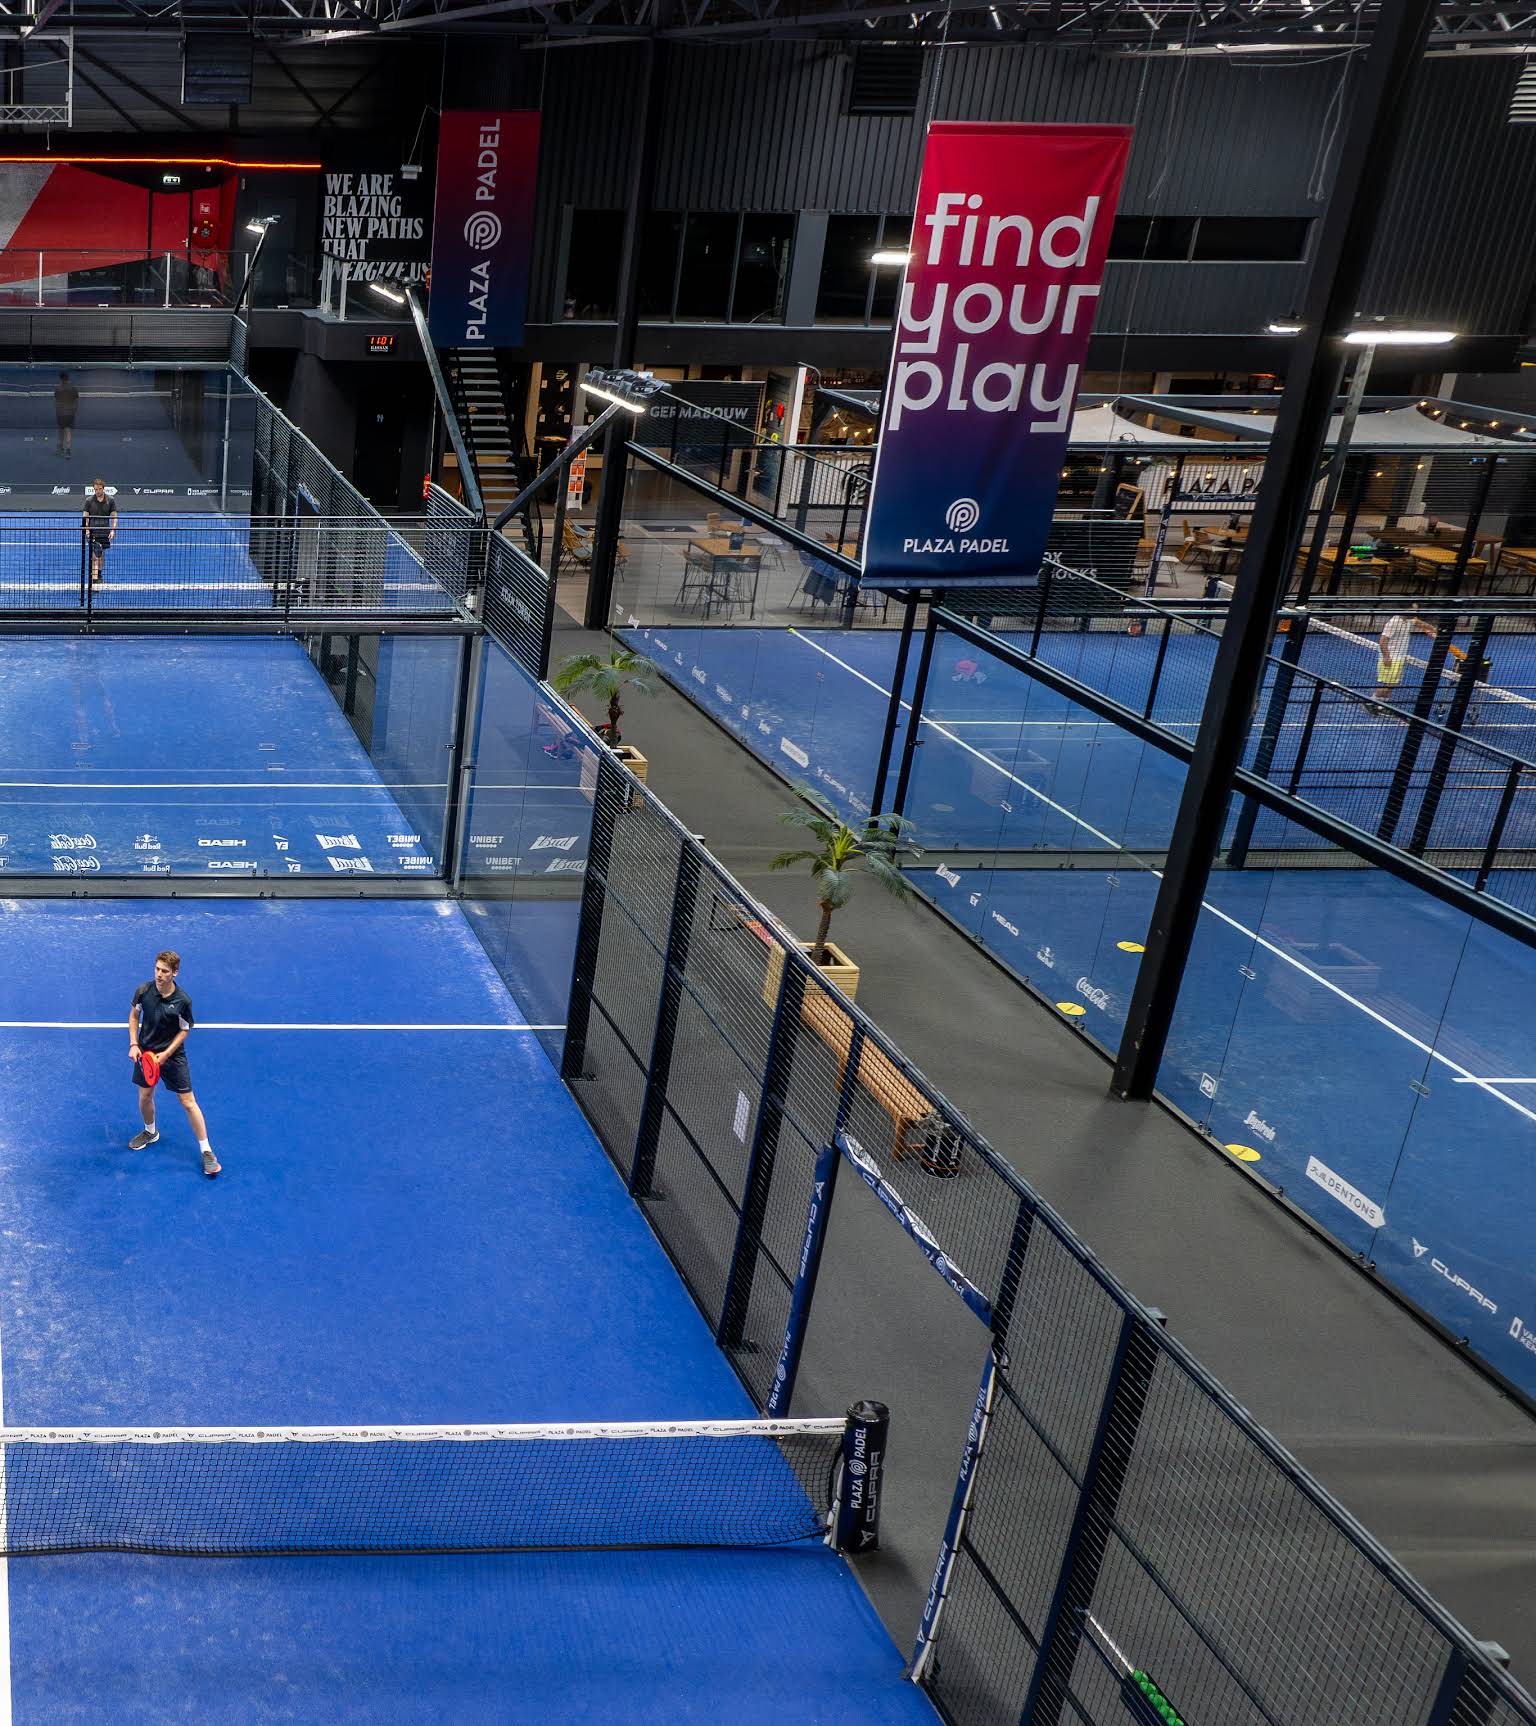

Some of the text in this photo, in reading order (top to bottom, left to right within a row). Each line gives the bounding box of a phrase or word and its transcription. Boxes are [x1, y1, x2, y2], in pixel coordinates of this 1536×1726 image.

[324, 196, 402, 217] BLAZING
[325, 174, 393, 195] WE ARE
[321, 239, 368, 260] THAT
[322, 218, 423, 239] NEW PATHS
[466, 119, 501, 340] PLAZA PADEL
[925, 193, 1100, 268] find
[899, 282, 1101, 353] your
[888, 343, 1079, 432] play
[904, 539, 1009, 553] PLAZA PADEL
[992, 911, 1019, 936] HEAD
[1327, 1177, 1376, 1219] DENTONS
[801, 1204, 818, 1278] CUPRA
[1431, 1258, 1498, 1314] CUPRA
[768, 1381, 781, 1410] PADEL
[851, 1427, 866, 1509] PLAZA PADEL
[866, 1451, 880, 1522] CUPRA
[924, 1540, 948, 1621] CUPRA
